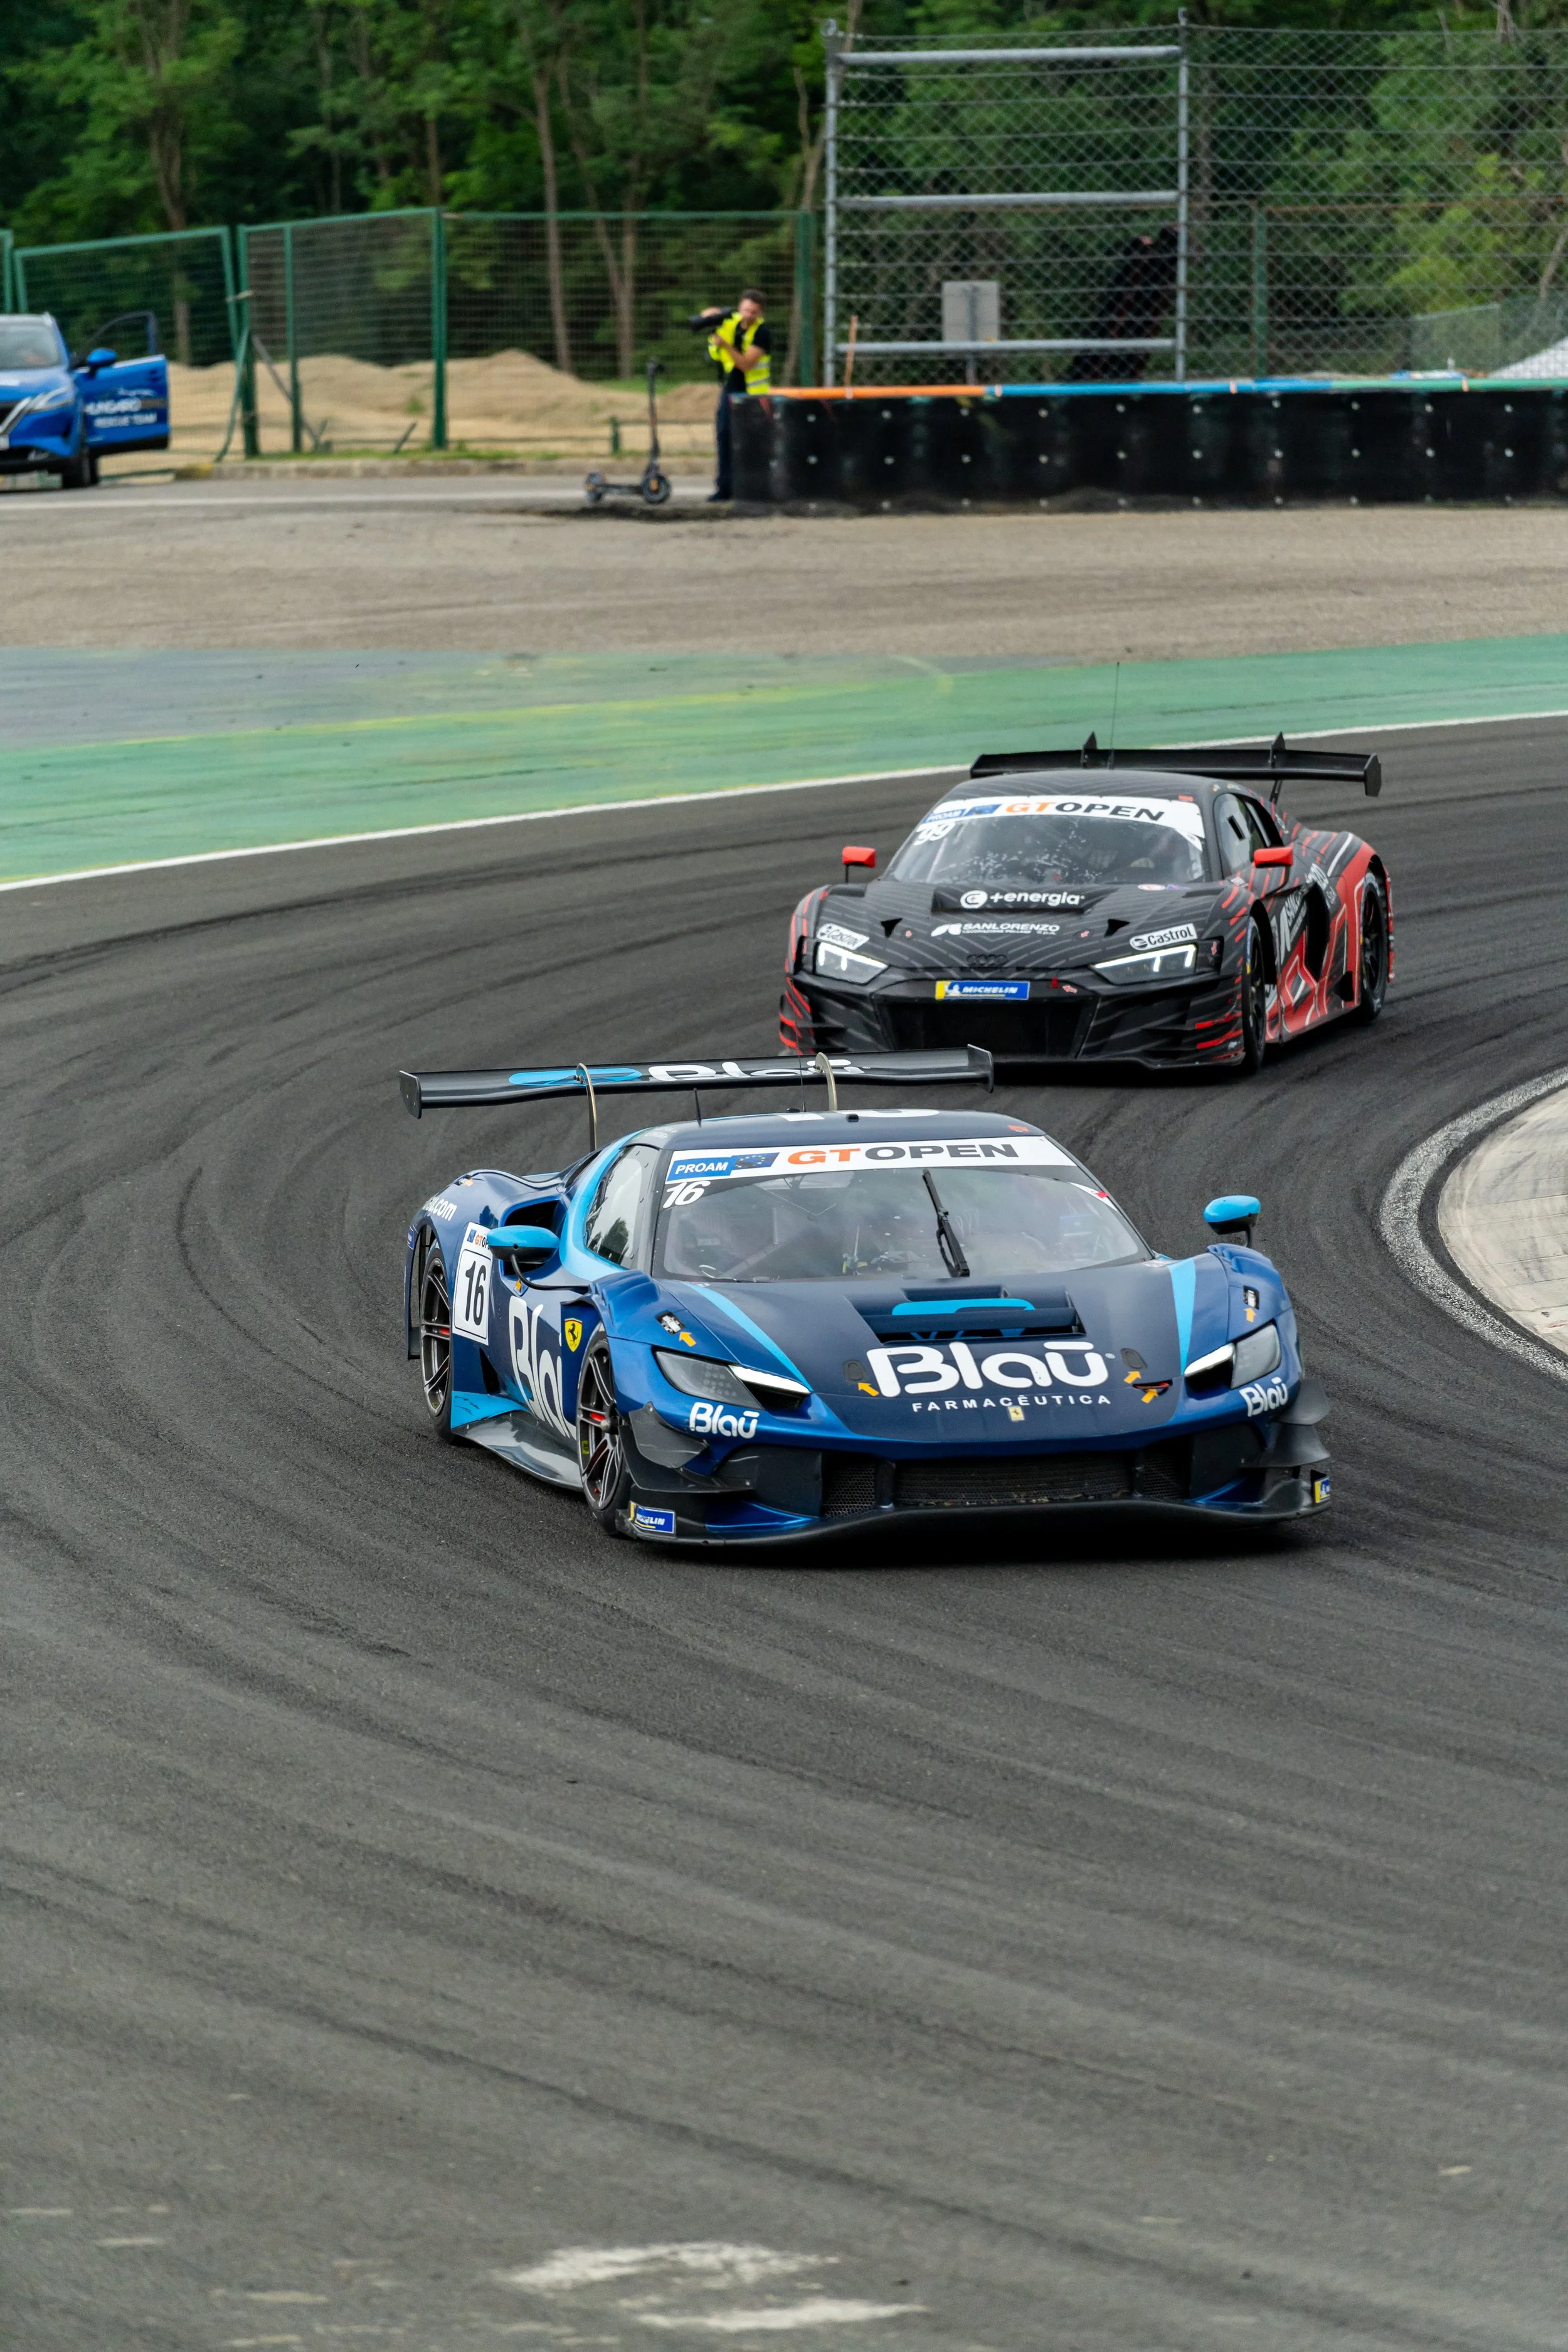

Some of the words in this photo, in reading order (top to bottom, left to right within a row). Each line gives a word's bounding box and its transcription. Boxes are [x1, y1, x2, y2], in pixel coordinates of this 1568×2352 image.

[963, 923, 1060, 932] SANLORENZO
[1148, 927, 1194, 945] Castrol
[962, 985, 1019, 993] MICHELIN
[675, 1162, 729, 1175] PROAM
[662, 1180, 711, 1209] 16
[465, 1260, 487, 1326] 16
[913, 1394, 1111, 1412] FARMACÊUTICA
